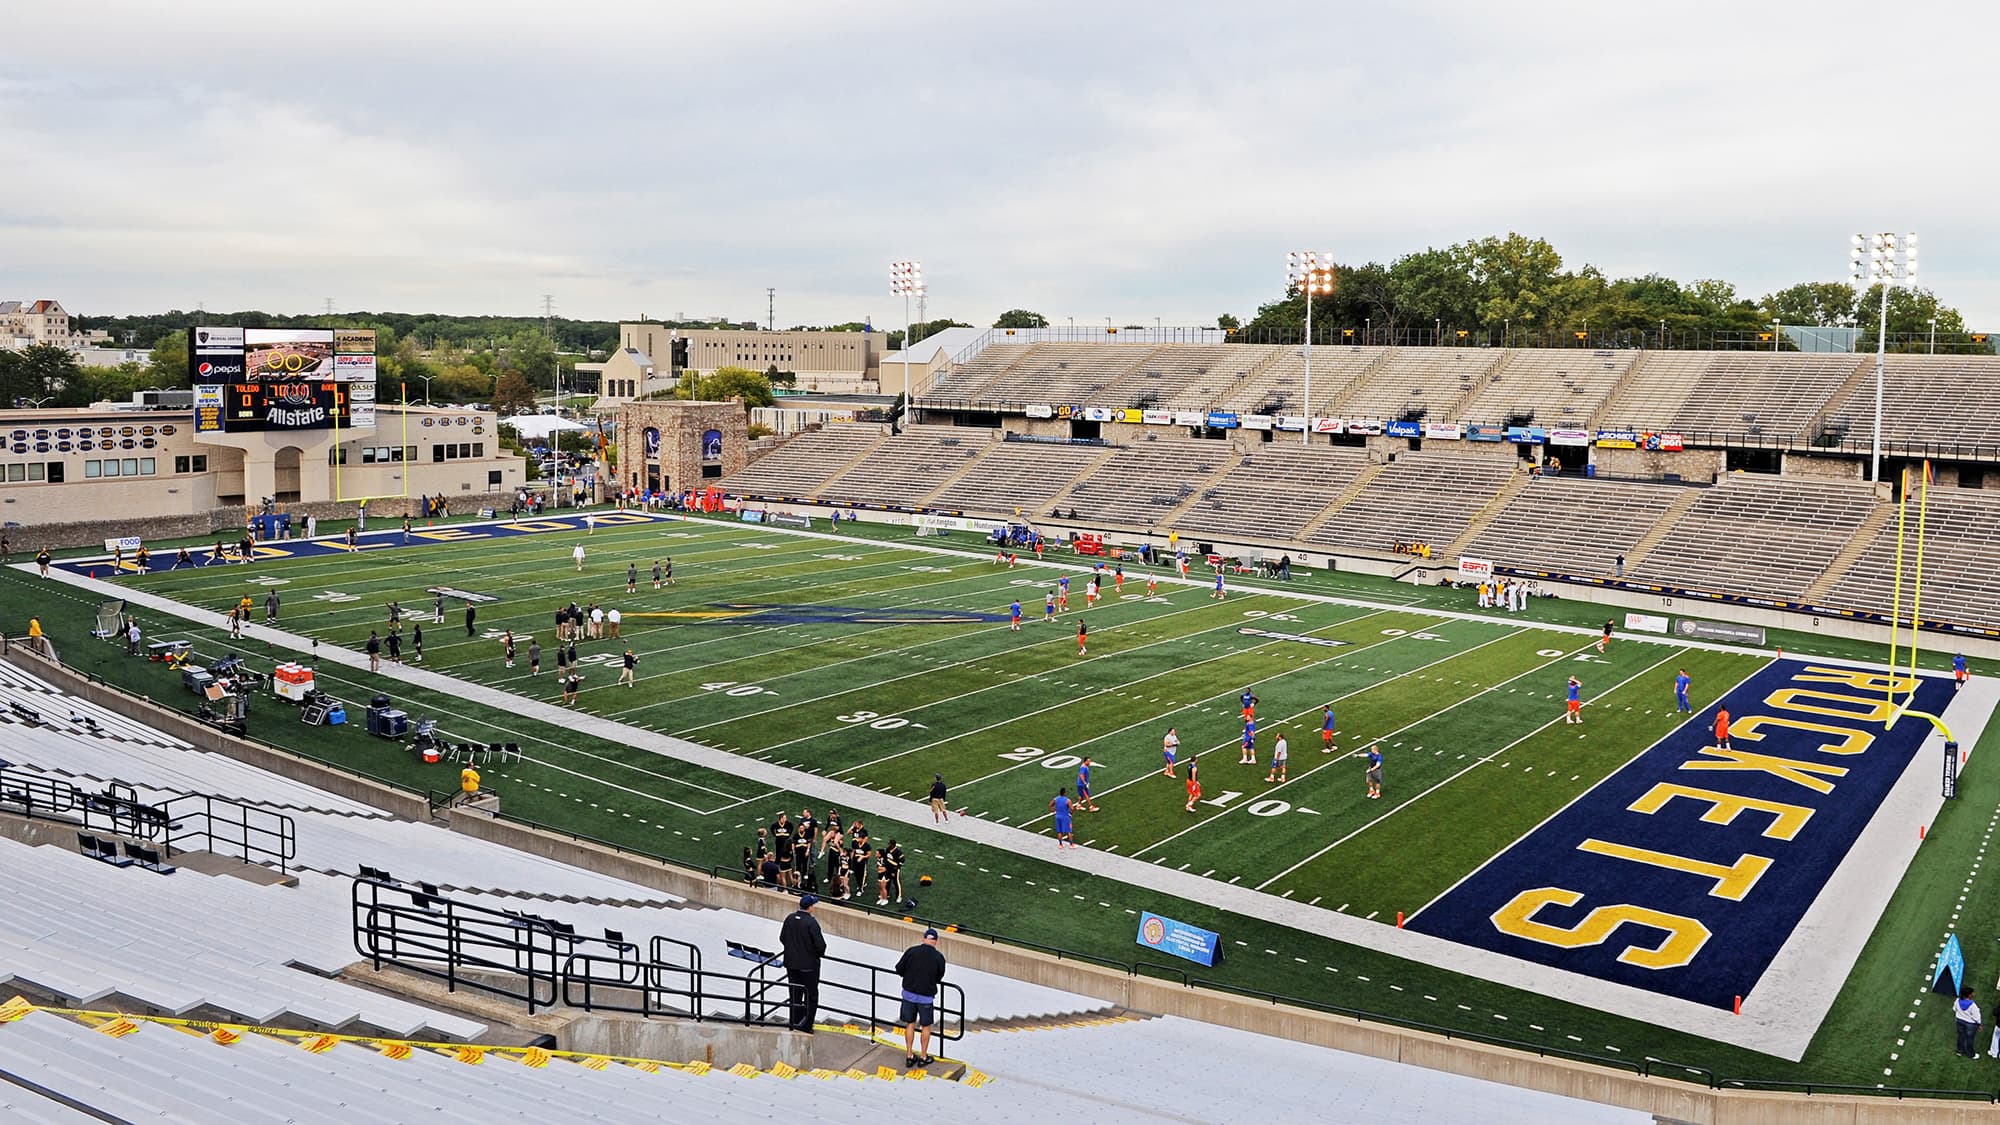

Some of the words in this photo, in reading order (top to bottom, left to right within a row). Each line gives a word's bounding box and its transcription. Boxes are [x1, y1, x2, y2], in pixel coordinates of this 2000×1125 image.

[213, 364, 241, 377] pepsi
[236, 384, 260, 392] TOLEDO
[243, 394, 252, 407] 0
[266, 407, 325, 426] Allstate
[1058, 406, 1071, 415] GO
[1389, 422, 1416, 436] Valpak
[119, 537, 141, 546] FOOD
[1103, 532, 1112, 540] 40
[1297, 553, 1308, 562] 40
[1462, 561, 1489, 572] ESPN
[1416, 569, 1427, 579] 30
[1527, 580, 1538, 589] 20
[1662, 597, 1673, 607] 10
[699, 681, 765, 698] 40
[836, 710, 911, 731] 30
[997, 746, 1084, 770] 20
[1200, 789, 1292, 817] 10
[1488, 664, 1924, 971] ROCKETS
